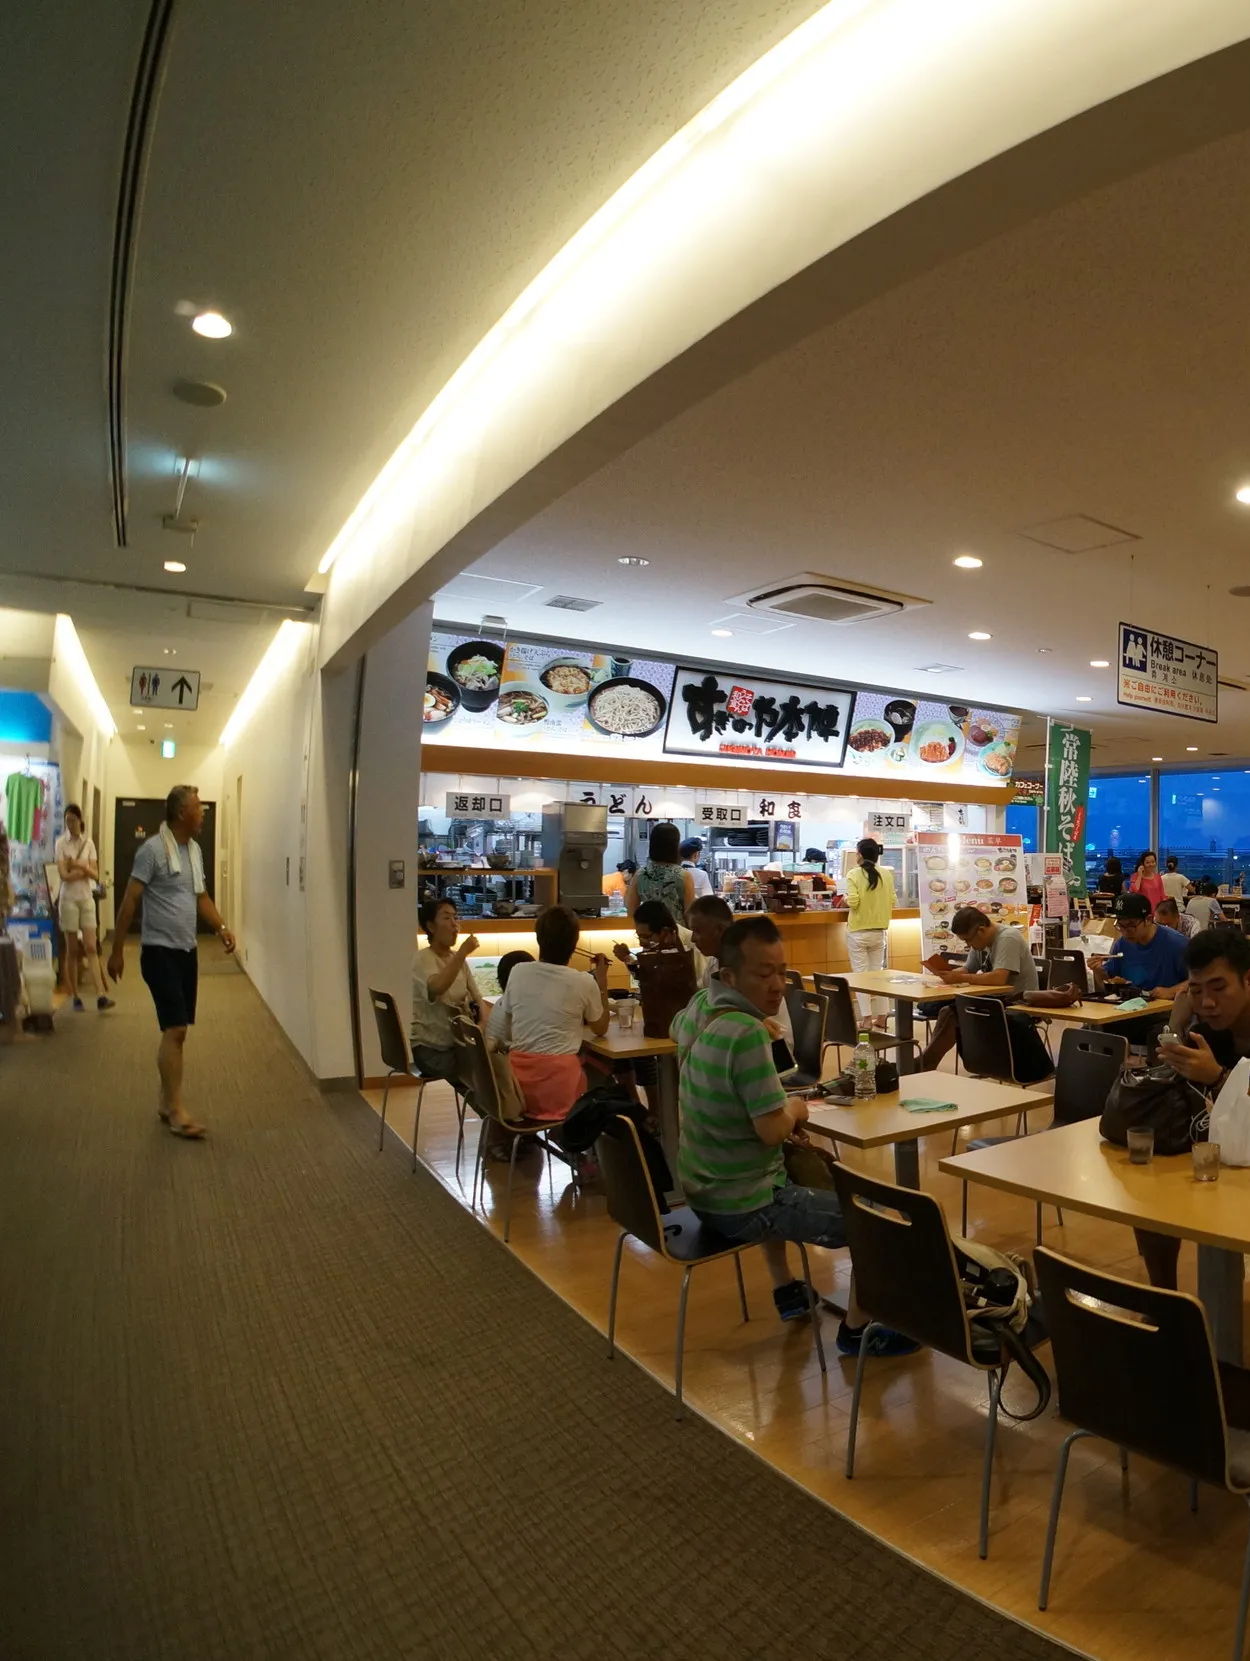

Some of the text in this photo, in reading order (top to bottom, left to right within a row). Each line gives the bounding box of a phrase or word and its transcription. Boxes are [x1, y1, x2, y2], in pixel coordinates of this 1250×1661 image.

[1150, 636, 1216, 669] 休憩コーナー
[1150, 660, 1187, 677] Break area
[454, 796, 503, 812] 返却口
[1058, 733, 1081, 865] 常陸秋そば
[702, 807, 742, 822] 受取口
[759, 798, 802, 820] 和食
[873, 814, 905, 828] 注文口
